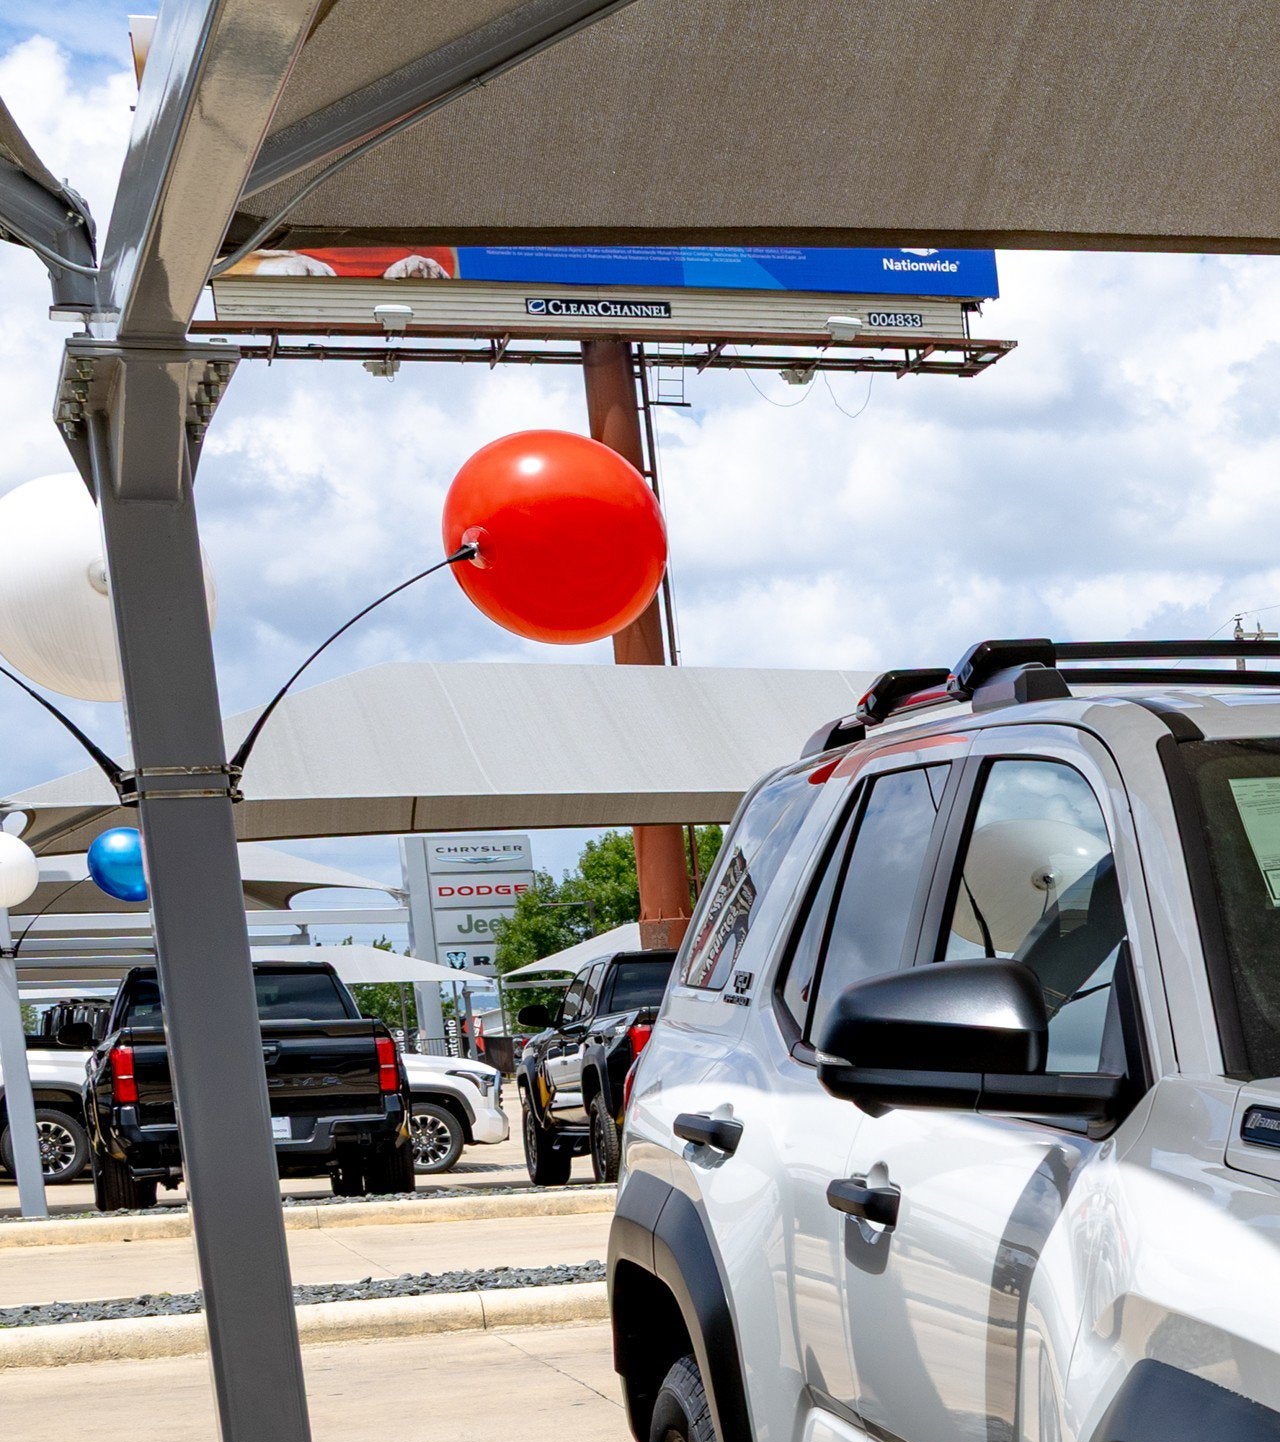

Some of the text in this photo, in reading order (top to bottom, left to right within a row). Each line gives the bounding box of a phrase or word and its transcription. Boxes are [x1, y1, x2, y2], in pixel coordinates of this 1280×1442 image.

[883, 258, 957, 272] Nationwide
[870, 313, 922, 326] 004833
[436, 845, 522, 853] CHRYSLER
[438, 884, 529, 897] DODGE
[457, 914, 503, 934] Jee
